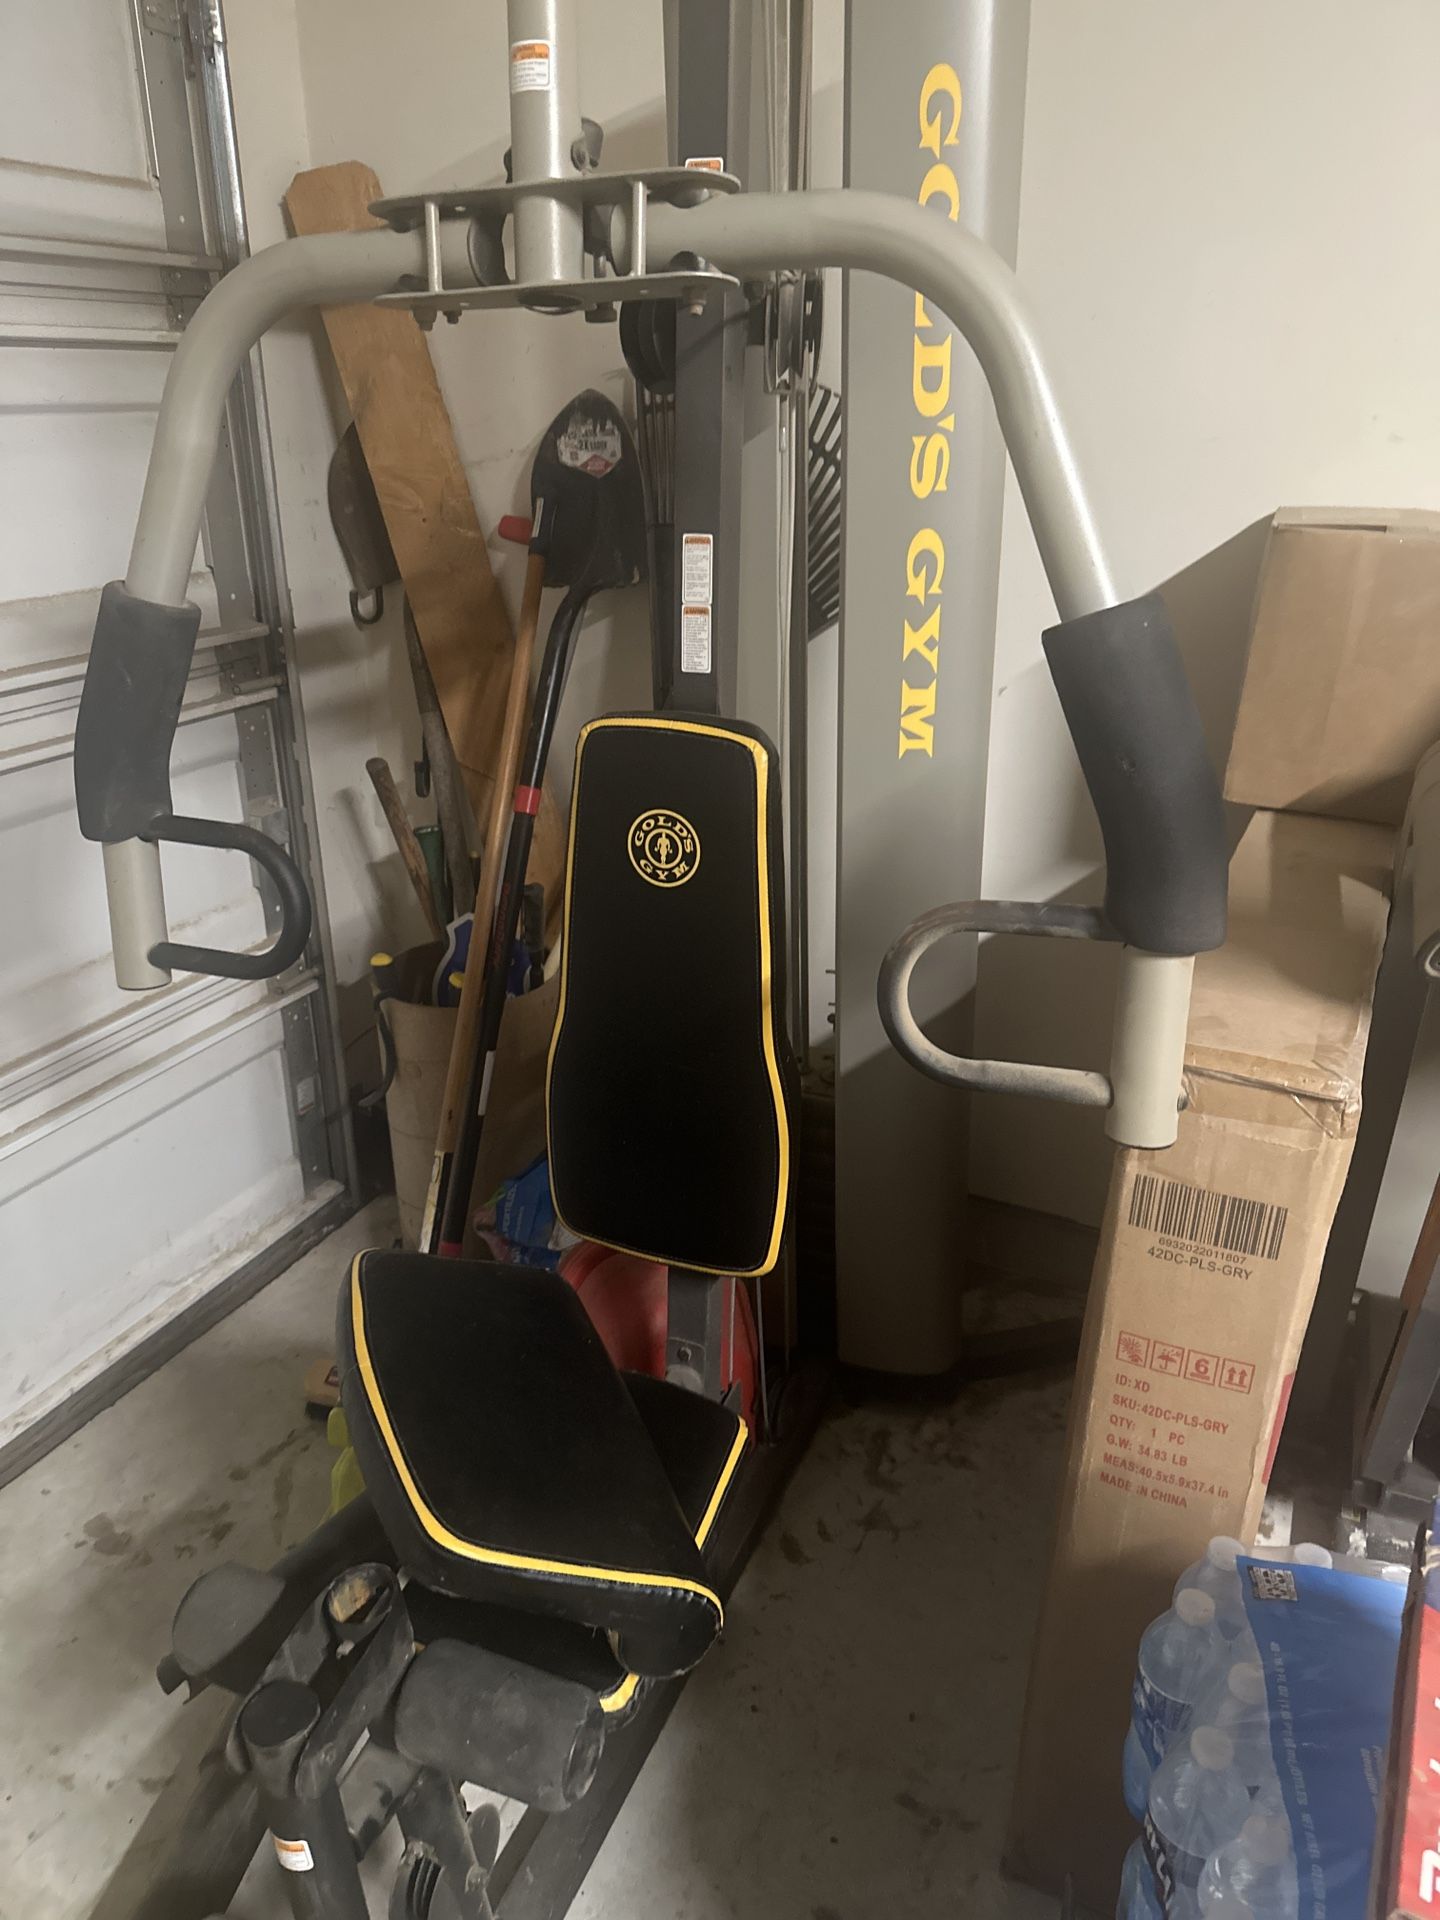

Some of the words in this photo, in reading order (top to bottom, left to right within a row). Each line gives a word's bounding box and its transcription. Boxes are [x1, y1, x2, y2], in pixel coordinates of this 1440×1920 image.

[909, 63, 962, 499] GOD'S
[899, 528, 945, 760] GYM
[634, 815, 694, 854] GOLD'S
[639, 858, 690, 881] GYM
[1147, 1246, 1253, 1280] 42DC-PLS-GRY
[1158, 1236, 1247, 1265] 6932022011807
[1115, 1373, 1131, 1387] ID:
[1134, 1379, 1150, 1393] XD
[1109, 1414, 1135, 1431] QTY:
[1168, 1431, 1185, 1445] PC
[1106, 1433, 1132, 1451] G.W:
[1172, 1454, 1188, 1468] LB
[1099, 1471, 1131, 1492] MADE
[1151, 1488, 1188, 1508] CHINA
